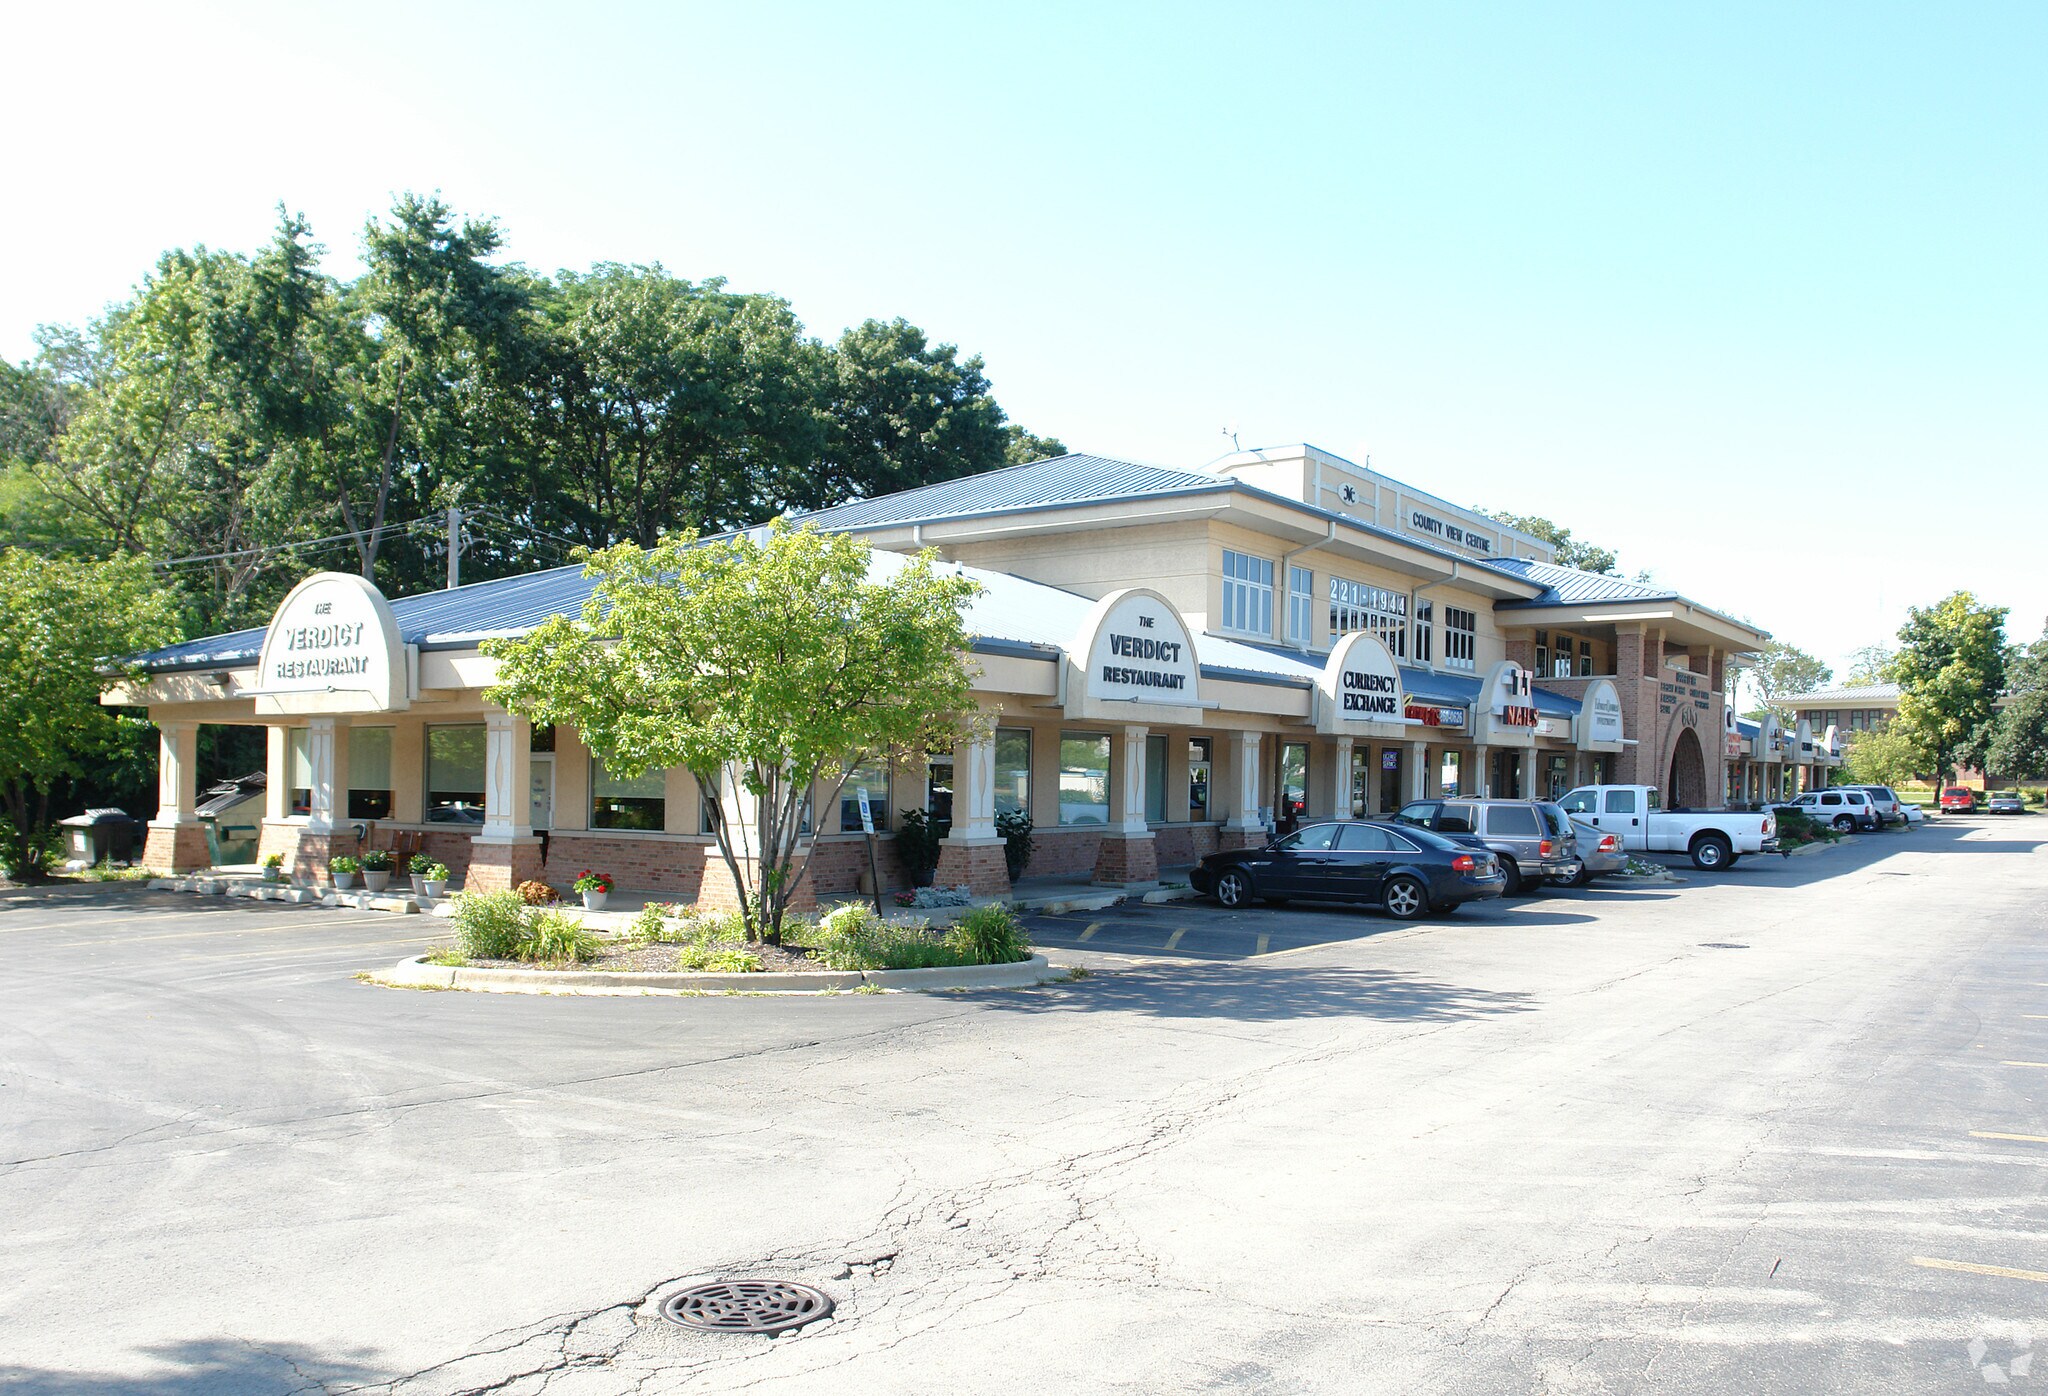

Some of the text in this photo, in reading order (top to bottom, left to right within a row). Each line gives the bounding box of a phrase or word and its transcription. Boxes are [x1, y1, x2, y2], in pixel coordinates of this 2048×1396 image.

[1412, 511, 1490, 553] COUNTY VIEW CENTRE
[1330, 579, 1405, 615] 221-1944
[1139, 616, 1155, 628] THE
[286, 621, 364, 651] VERDICT
[1110, 633, 1181, 663] VERDICT
[277, 656, 369, 679] RESTAURANT
[1103, 666, 1186, 690] RESTAURANT
[1343, 671, 1396, 693] CURRENCY
[1343, 693, 1397, 714] EXCHANGE
[1504, 705, 1539, 727] NAILS
